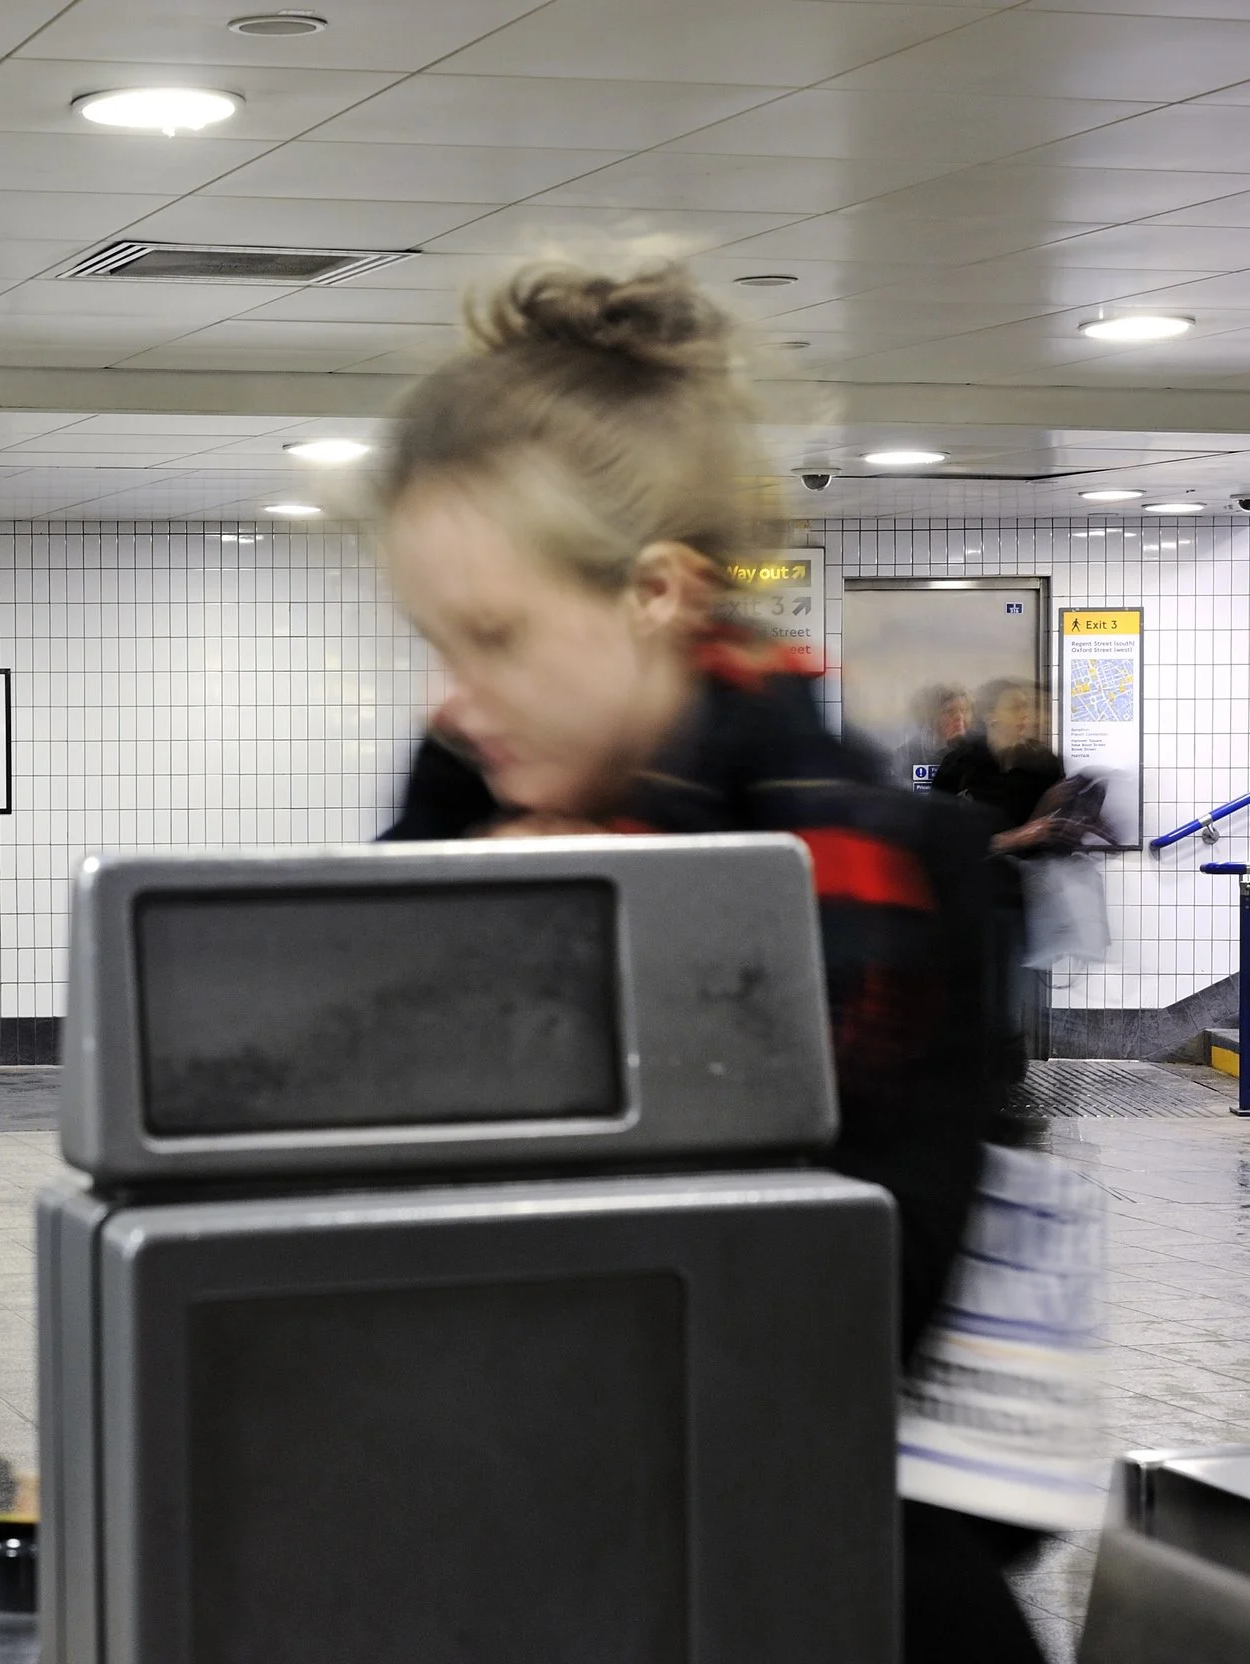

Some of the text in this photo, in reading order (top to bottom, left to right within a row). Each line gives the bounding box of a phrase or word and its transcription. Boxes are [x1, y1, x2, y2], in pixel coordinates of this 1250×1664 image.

[759, 566, 789, 580] out
[772, 595, 785, 616] 3
[1086, 620, 1118, 630] Exit 3
[772, 627, 811, 638] Street
